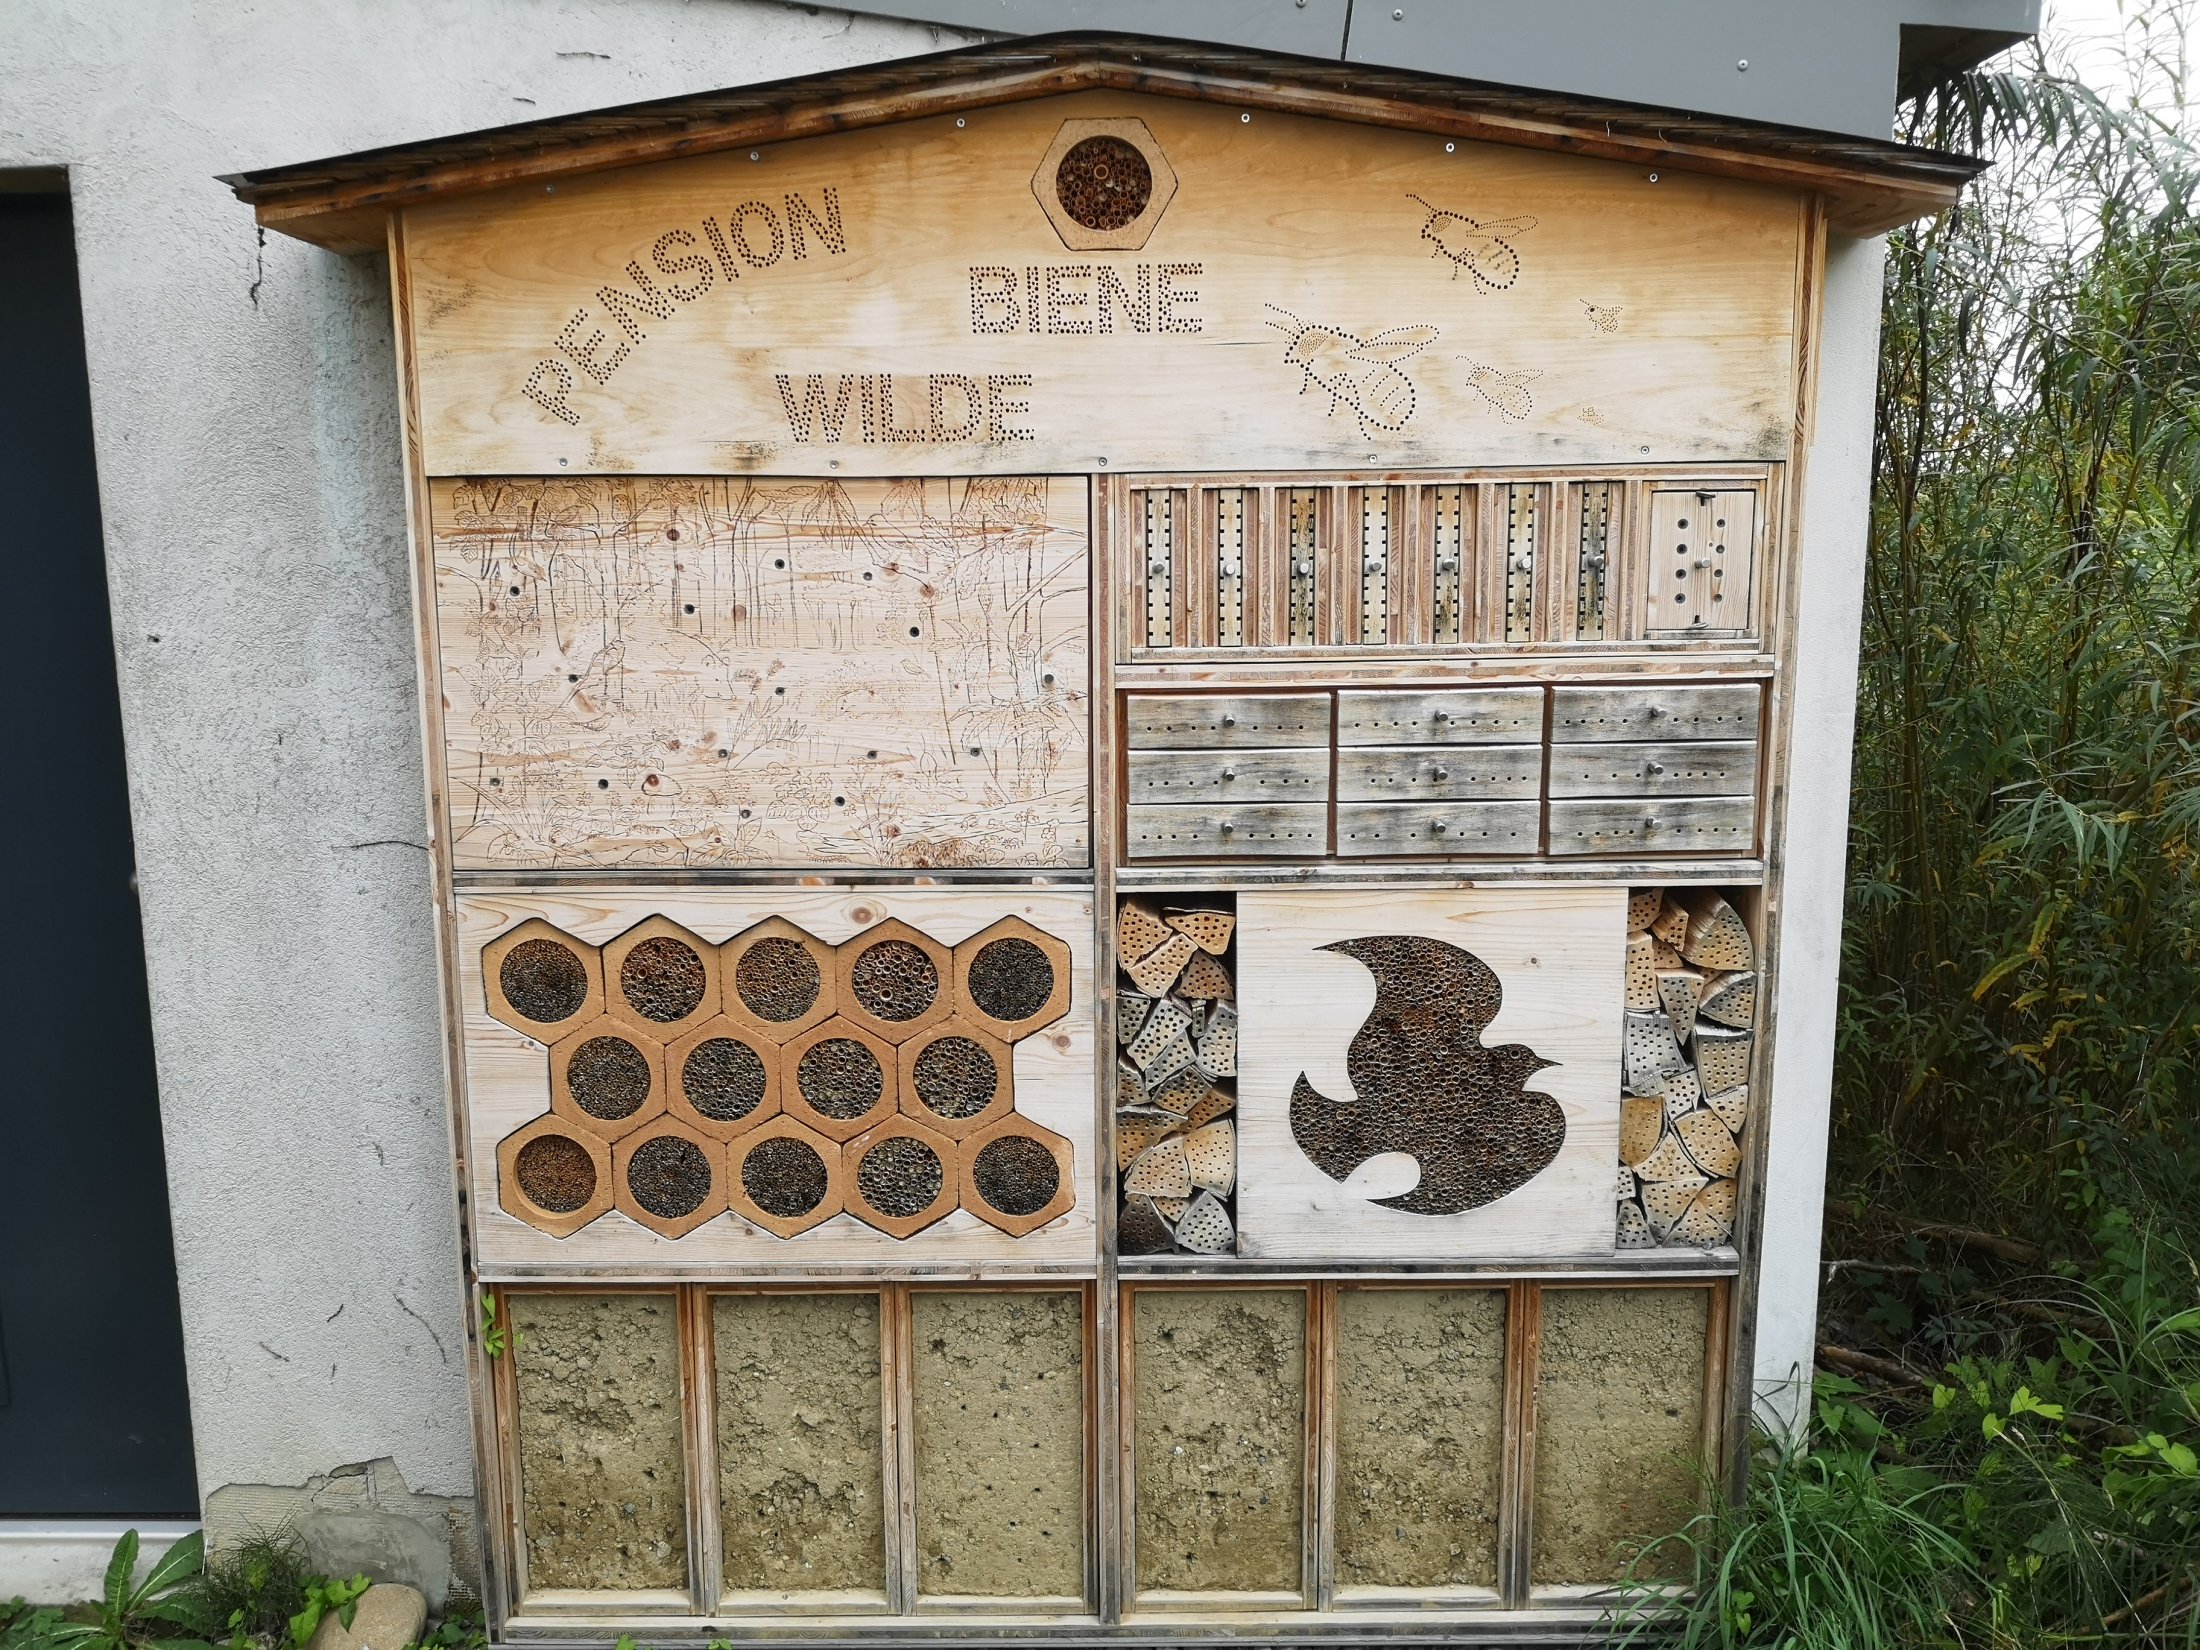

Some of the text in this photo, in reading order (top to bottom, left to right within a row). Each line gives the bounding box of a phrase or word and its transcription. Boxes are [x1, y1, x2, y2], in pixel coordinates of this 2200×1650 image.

[522, 188, 846, 427] PENSION
[970, 263, 1204, 335] BIENE
[775, 374, 1034, 444] WILDE
